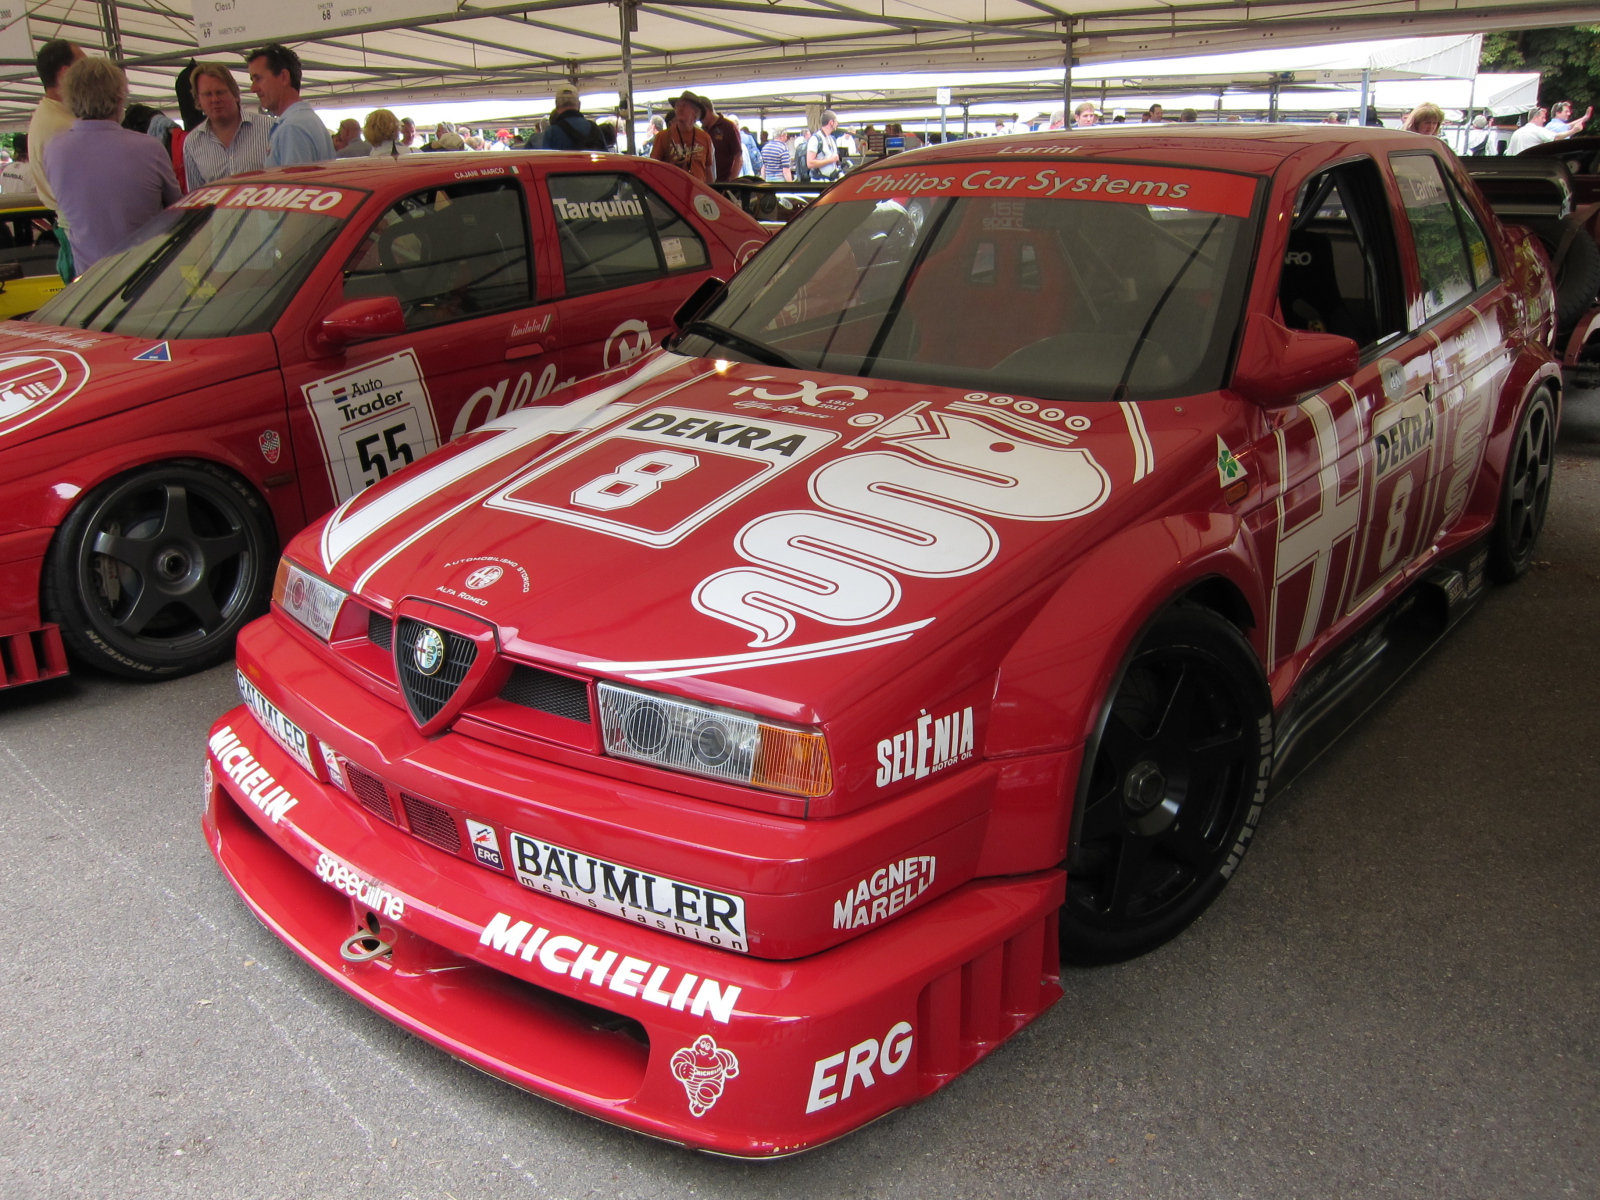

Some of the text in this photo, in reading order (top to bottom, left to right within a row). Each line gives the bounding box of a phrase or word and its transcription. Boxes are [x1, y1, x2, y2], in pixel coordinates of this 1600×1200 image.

[214, 2, 231, 11] Class
[322, 9, 331, 20] 68
[203, 28, 211, 38] 69
[997, 145, 1083, 155] Larini
[454, 167, 505, 179] CAJANI MARCO
[855, 169, 1191, 199] Philips Car Systems
[170, 187, 343, 211] ALFA ROMEO
[552, 194, 644, 222] Tarquini
[702, 203, 714, 215] 47
[338, 390, 403, 422] Trader
[352, 379, 383, 399] Auto
[626, 413, 808, 457] DEKRA
[1375, 405, 1434, 476] DEKRA
[356, 423, 414, 487] 55
[570, 450, 700, 512] 8
[1379, 471, 1414, 573] 8
[443, 556, 530, 593] AUTOMOBILISMO STORICO
[436, 585, 488, 607] ALFA ROMEO
[85, 629, 153, 672] MICHELIN
[208, 725, 299, 824] MICHELIN
[931, 751, 973, 773] MOTOR OIL
[1219, 713, 1273, 880] MICHELIN
[477, 848, 499, 864] ERG
[514, 835, 741, 937] BÄUMLER
[833, 856, 936, 912] MAGNETI
[520, 875, 743, 950] men's fashion
[479, 912, 742, 1024] MICHELIN
[805, 1021, 913, 1114] ERG
